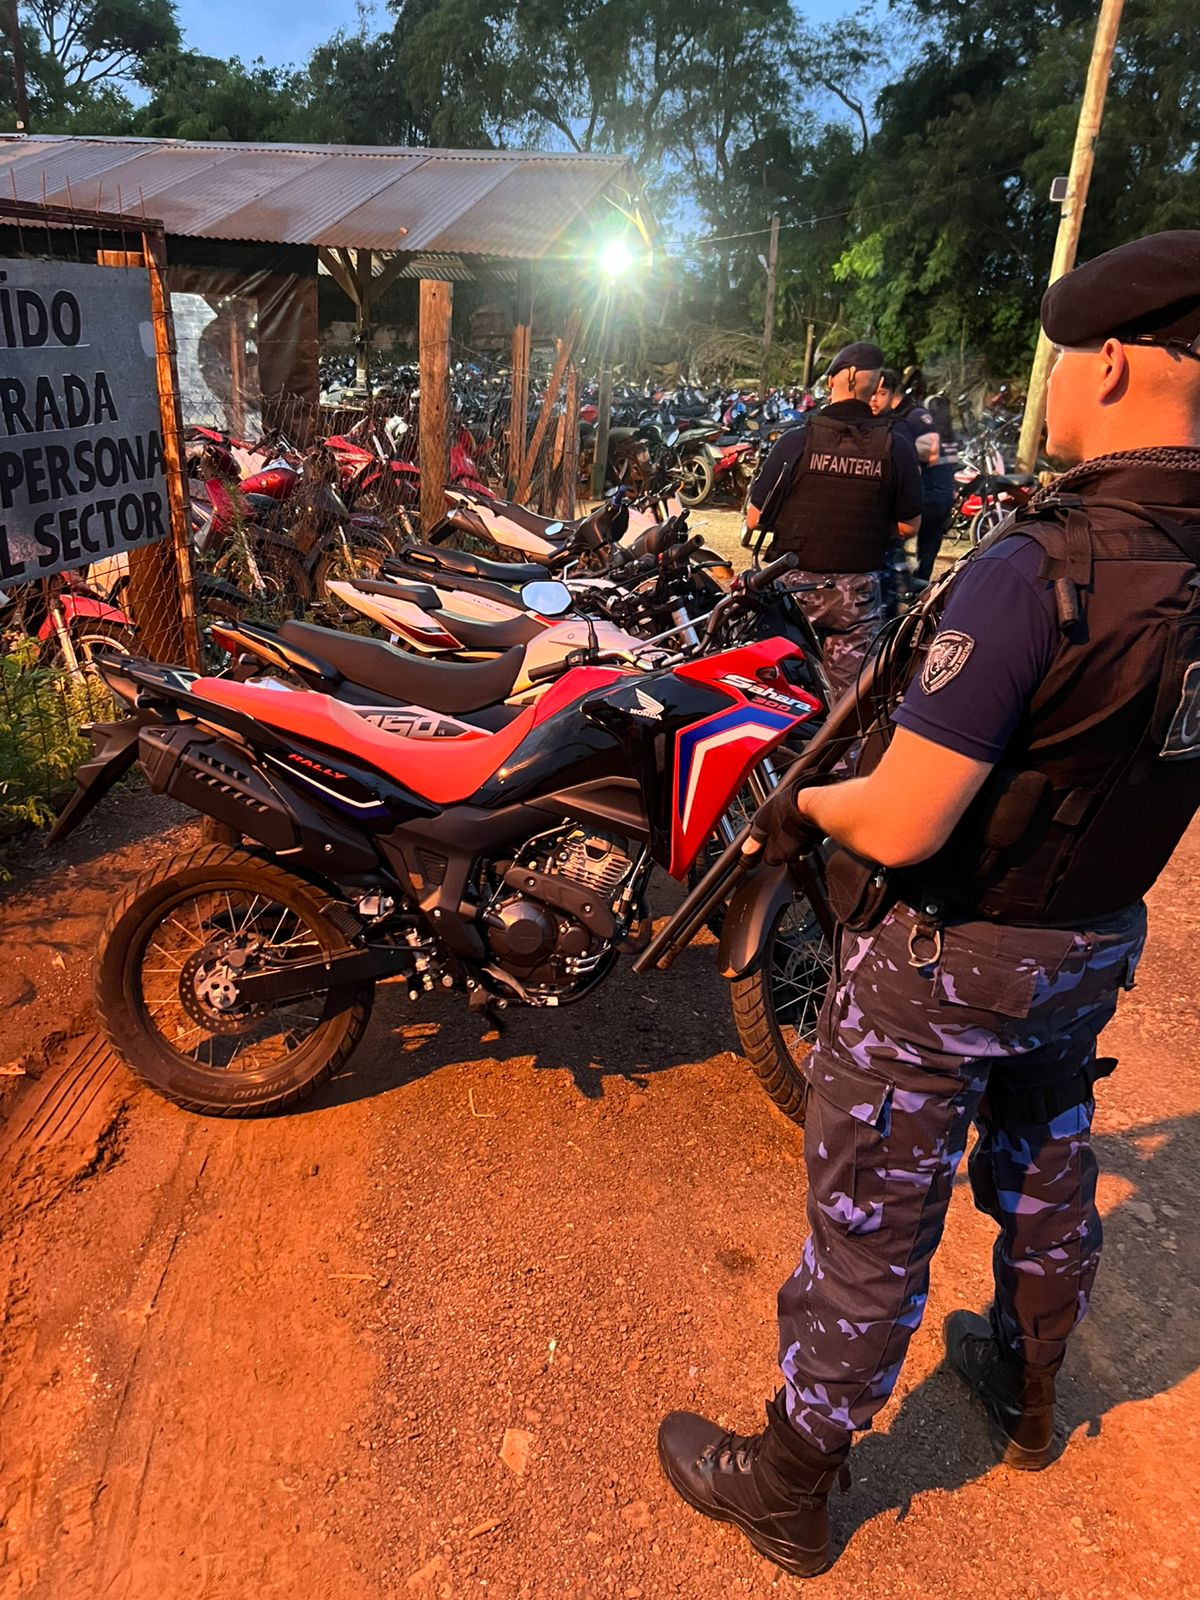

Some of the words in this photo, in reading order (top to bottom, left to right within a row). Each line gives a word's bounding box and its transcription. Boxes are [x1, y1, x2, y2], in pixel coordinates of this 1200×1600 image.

[0, 372, 119, 436] RADA
[0, 431, 166, 509] PERSONA
[809, 453, 882, 477] INFANTERIA
[34, 492, 165, 568] SECTOR
[719, 674, 813, 712] Sahara
[629, 707, 663, 721] HONDA
[288, 753, 348, 779] RALLY
